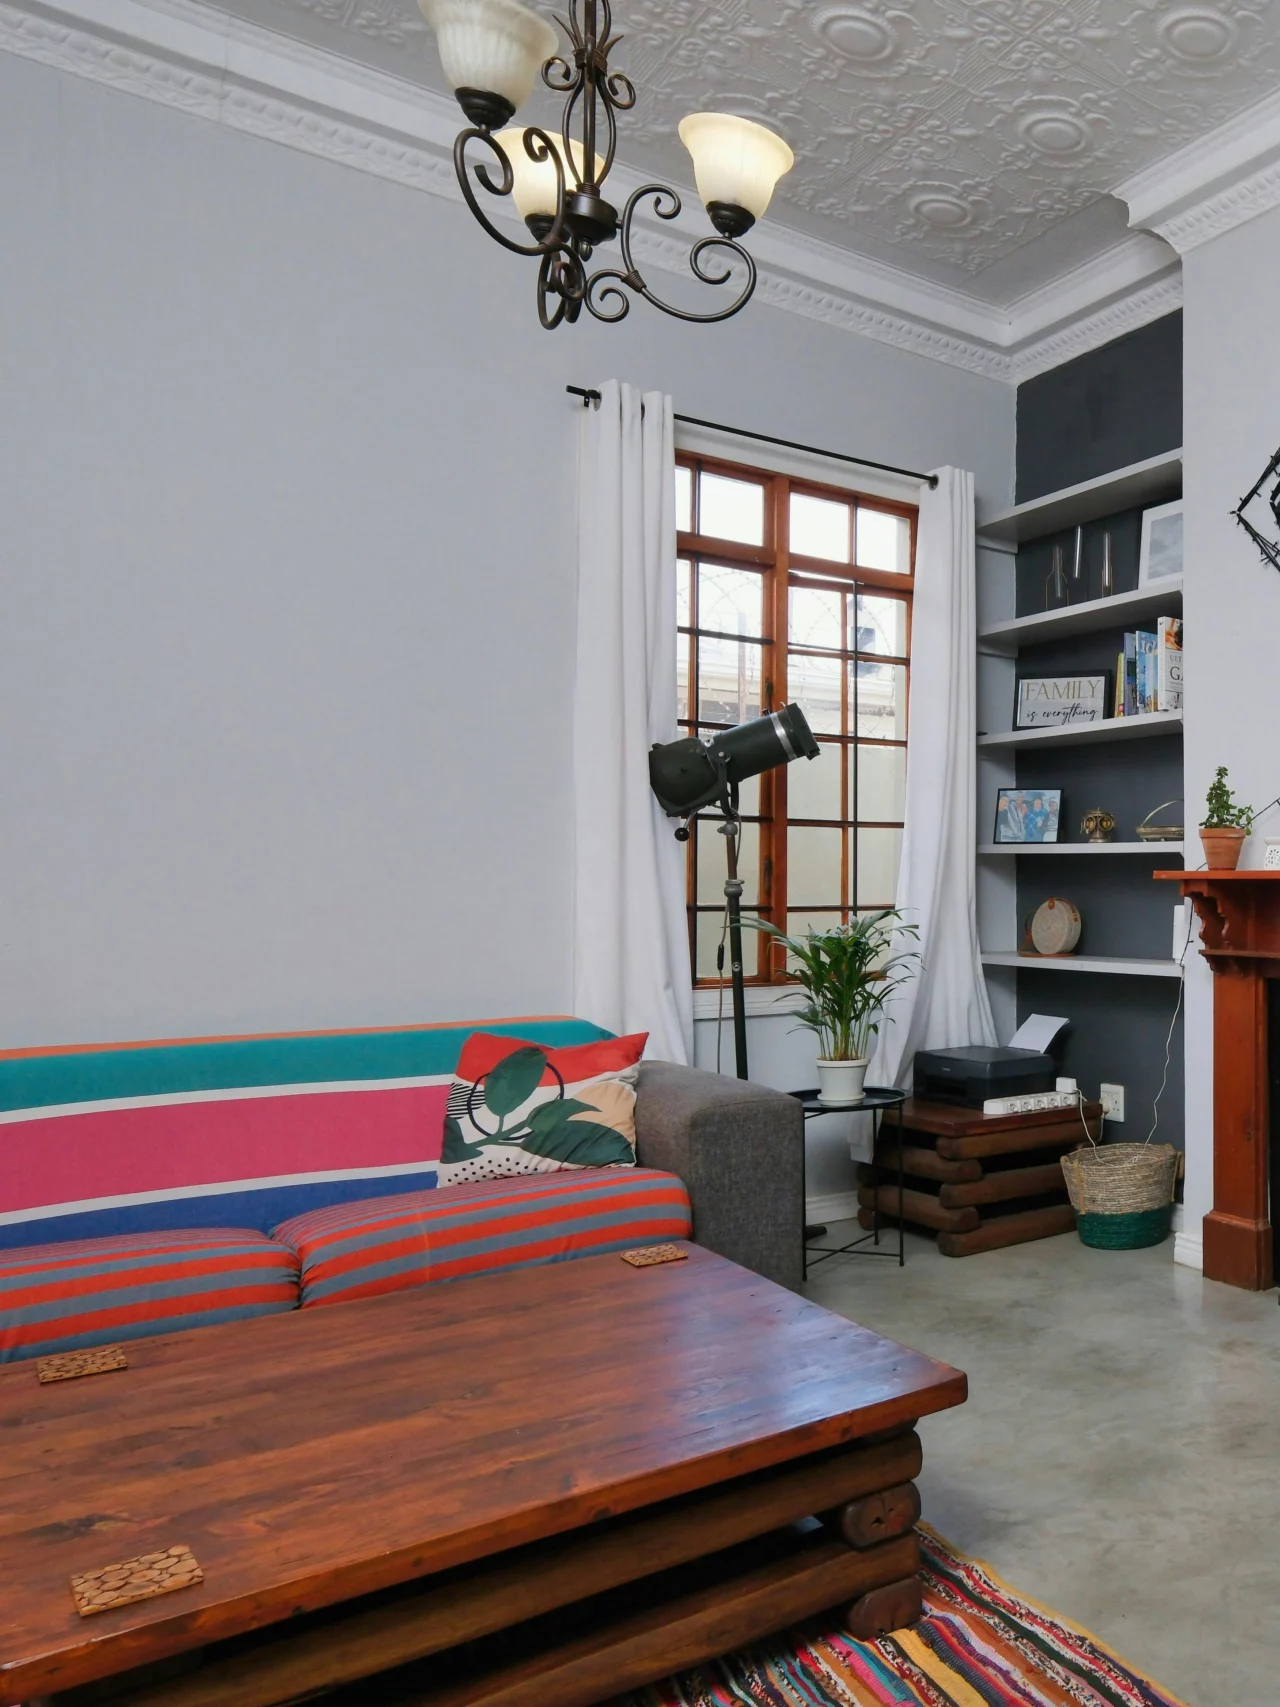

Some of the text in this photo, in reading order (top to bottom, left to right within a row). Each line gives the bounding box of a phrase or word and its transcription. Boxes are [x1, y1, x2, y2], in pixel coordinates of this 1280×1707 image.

[1025, 680, 1101, 701] FAMILY
[1026, 703, 1098, 726] is everything
